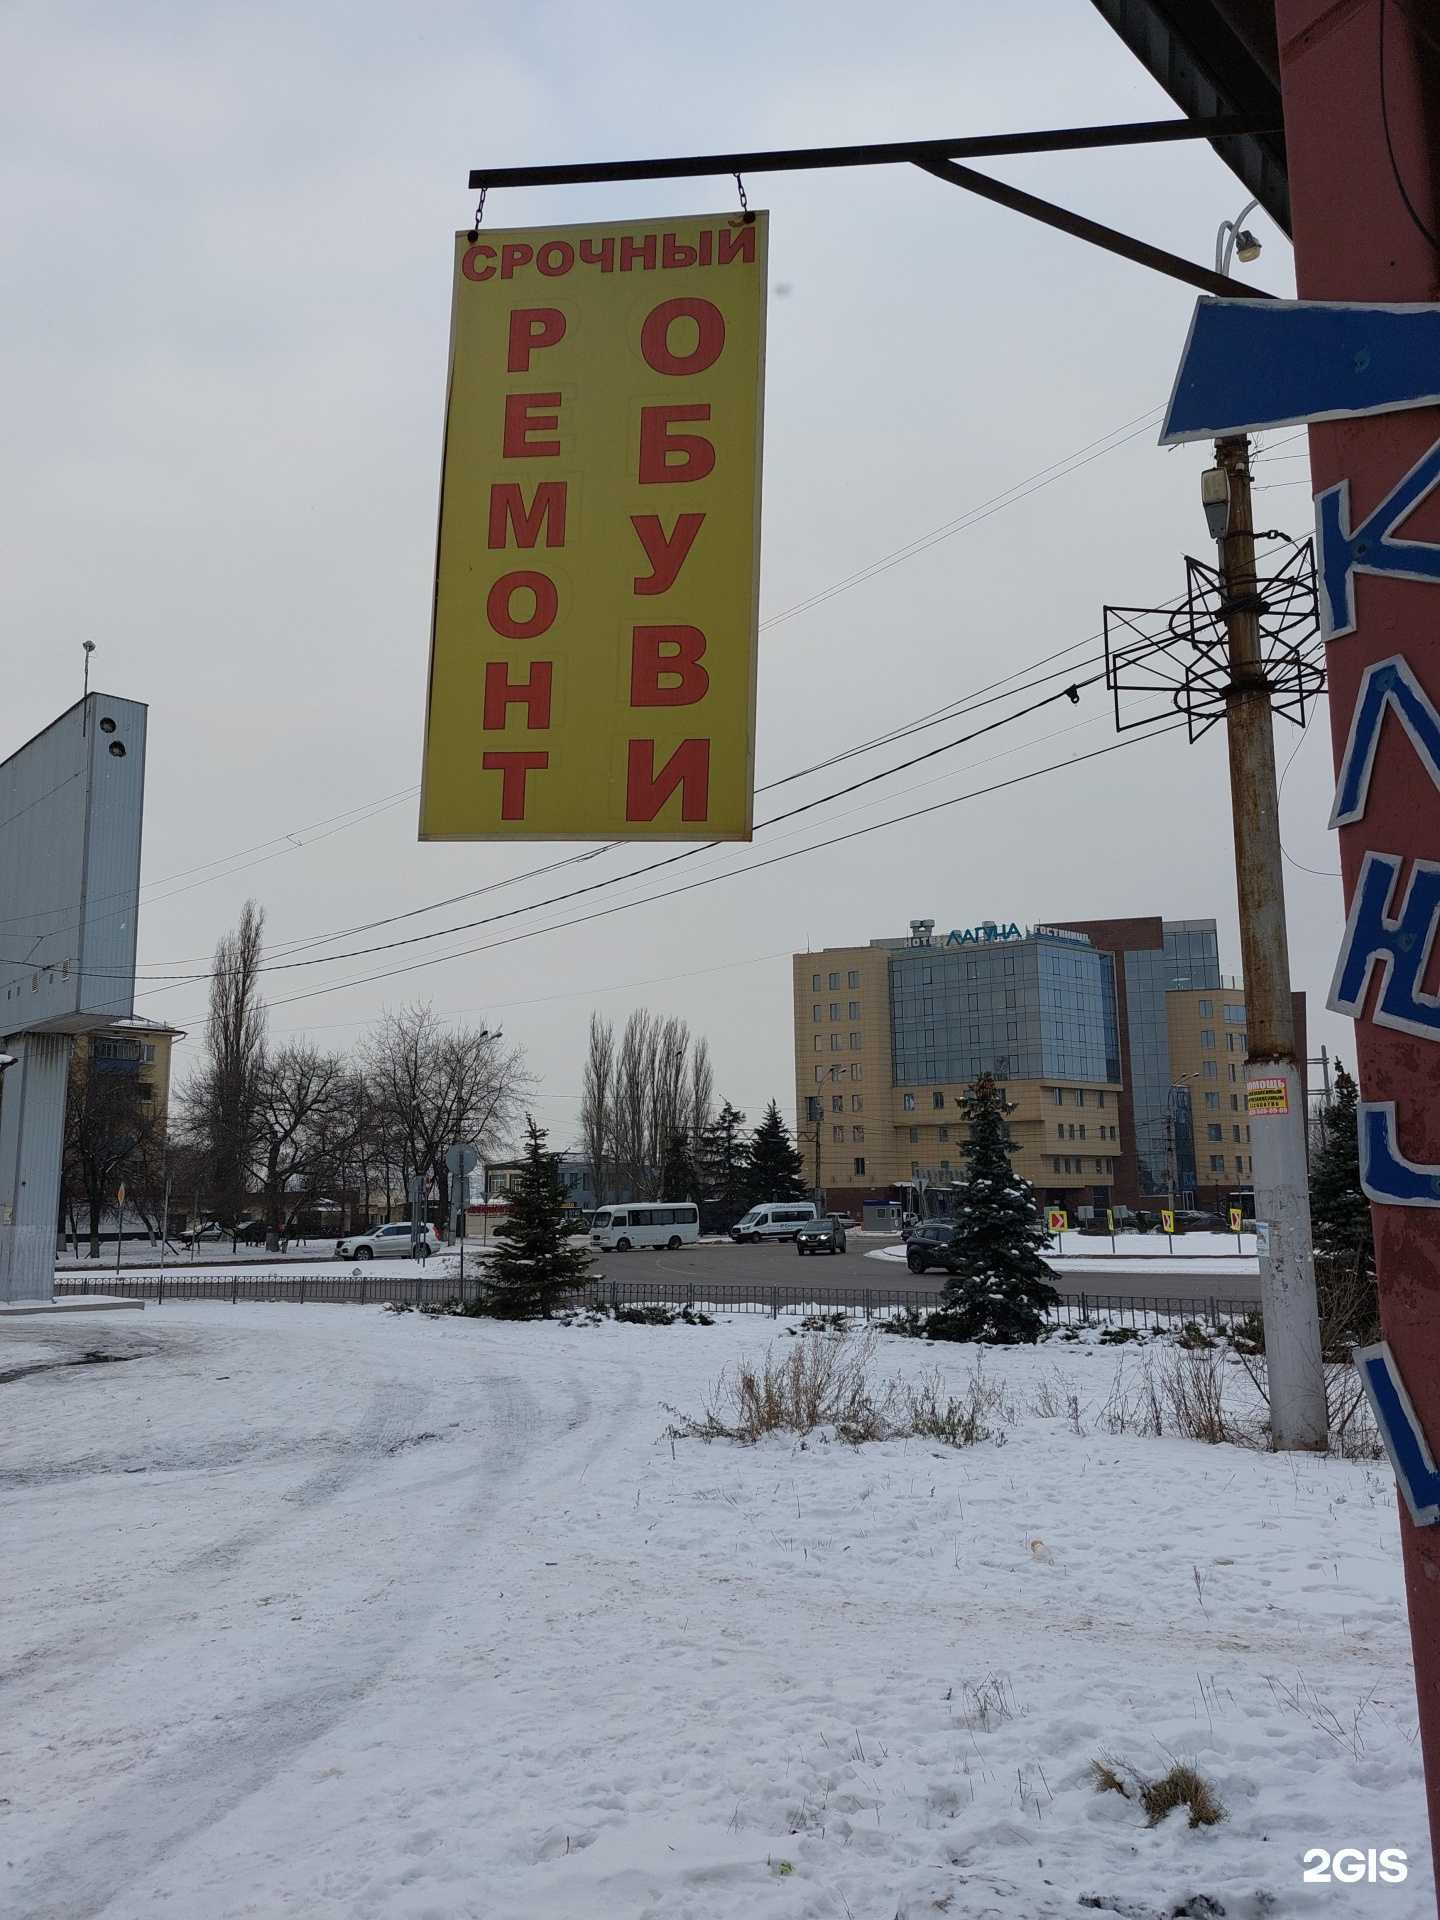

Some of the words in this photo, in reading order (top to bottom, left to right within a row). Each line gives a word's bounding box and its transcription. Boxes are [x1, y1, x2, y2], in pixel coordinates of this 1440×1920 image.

[462, 219, 756, 281] СРОЧНЫЙ
[482, 307, 567, 821] РЕМОНТ
[625, 297, 725, 822] ОБУВИ
[946, 922, 1022, 946] ЛАГУНА
